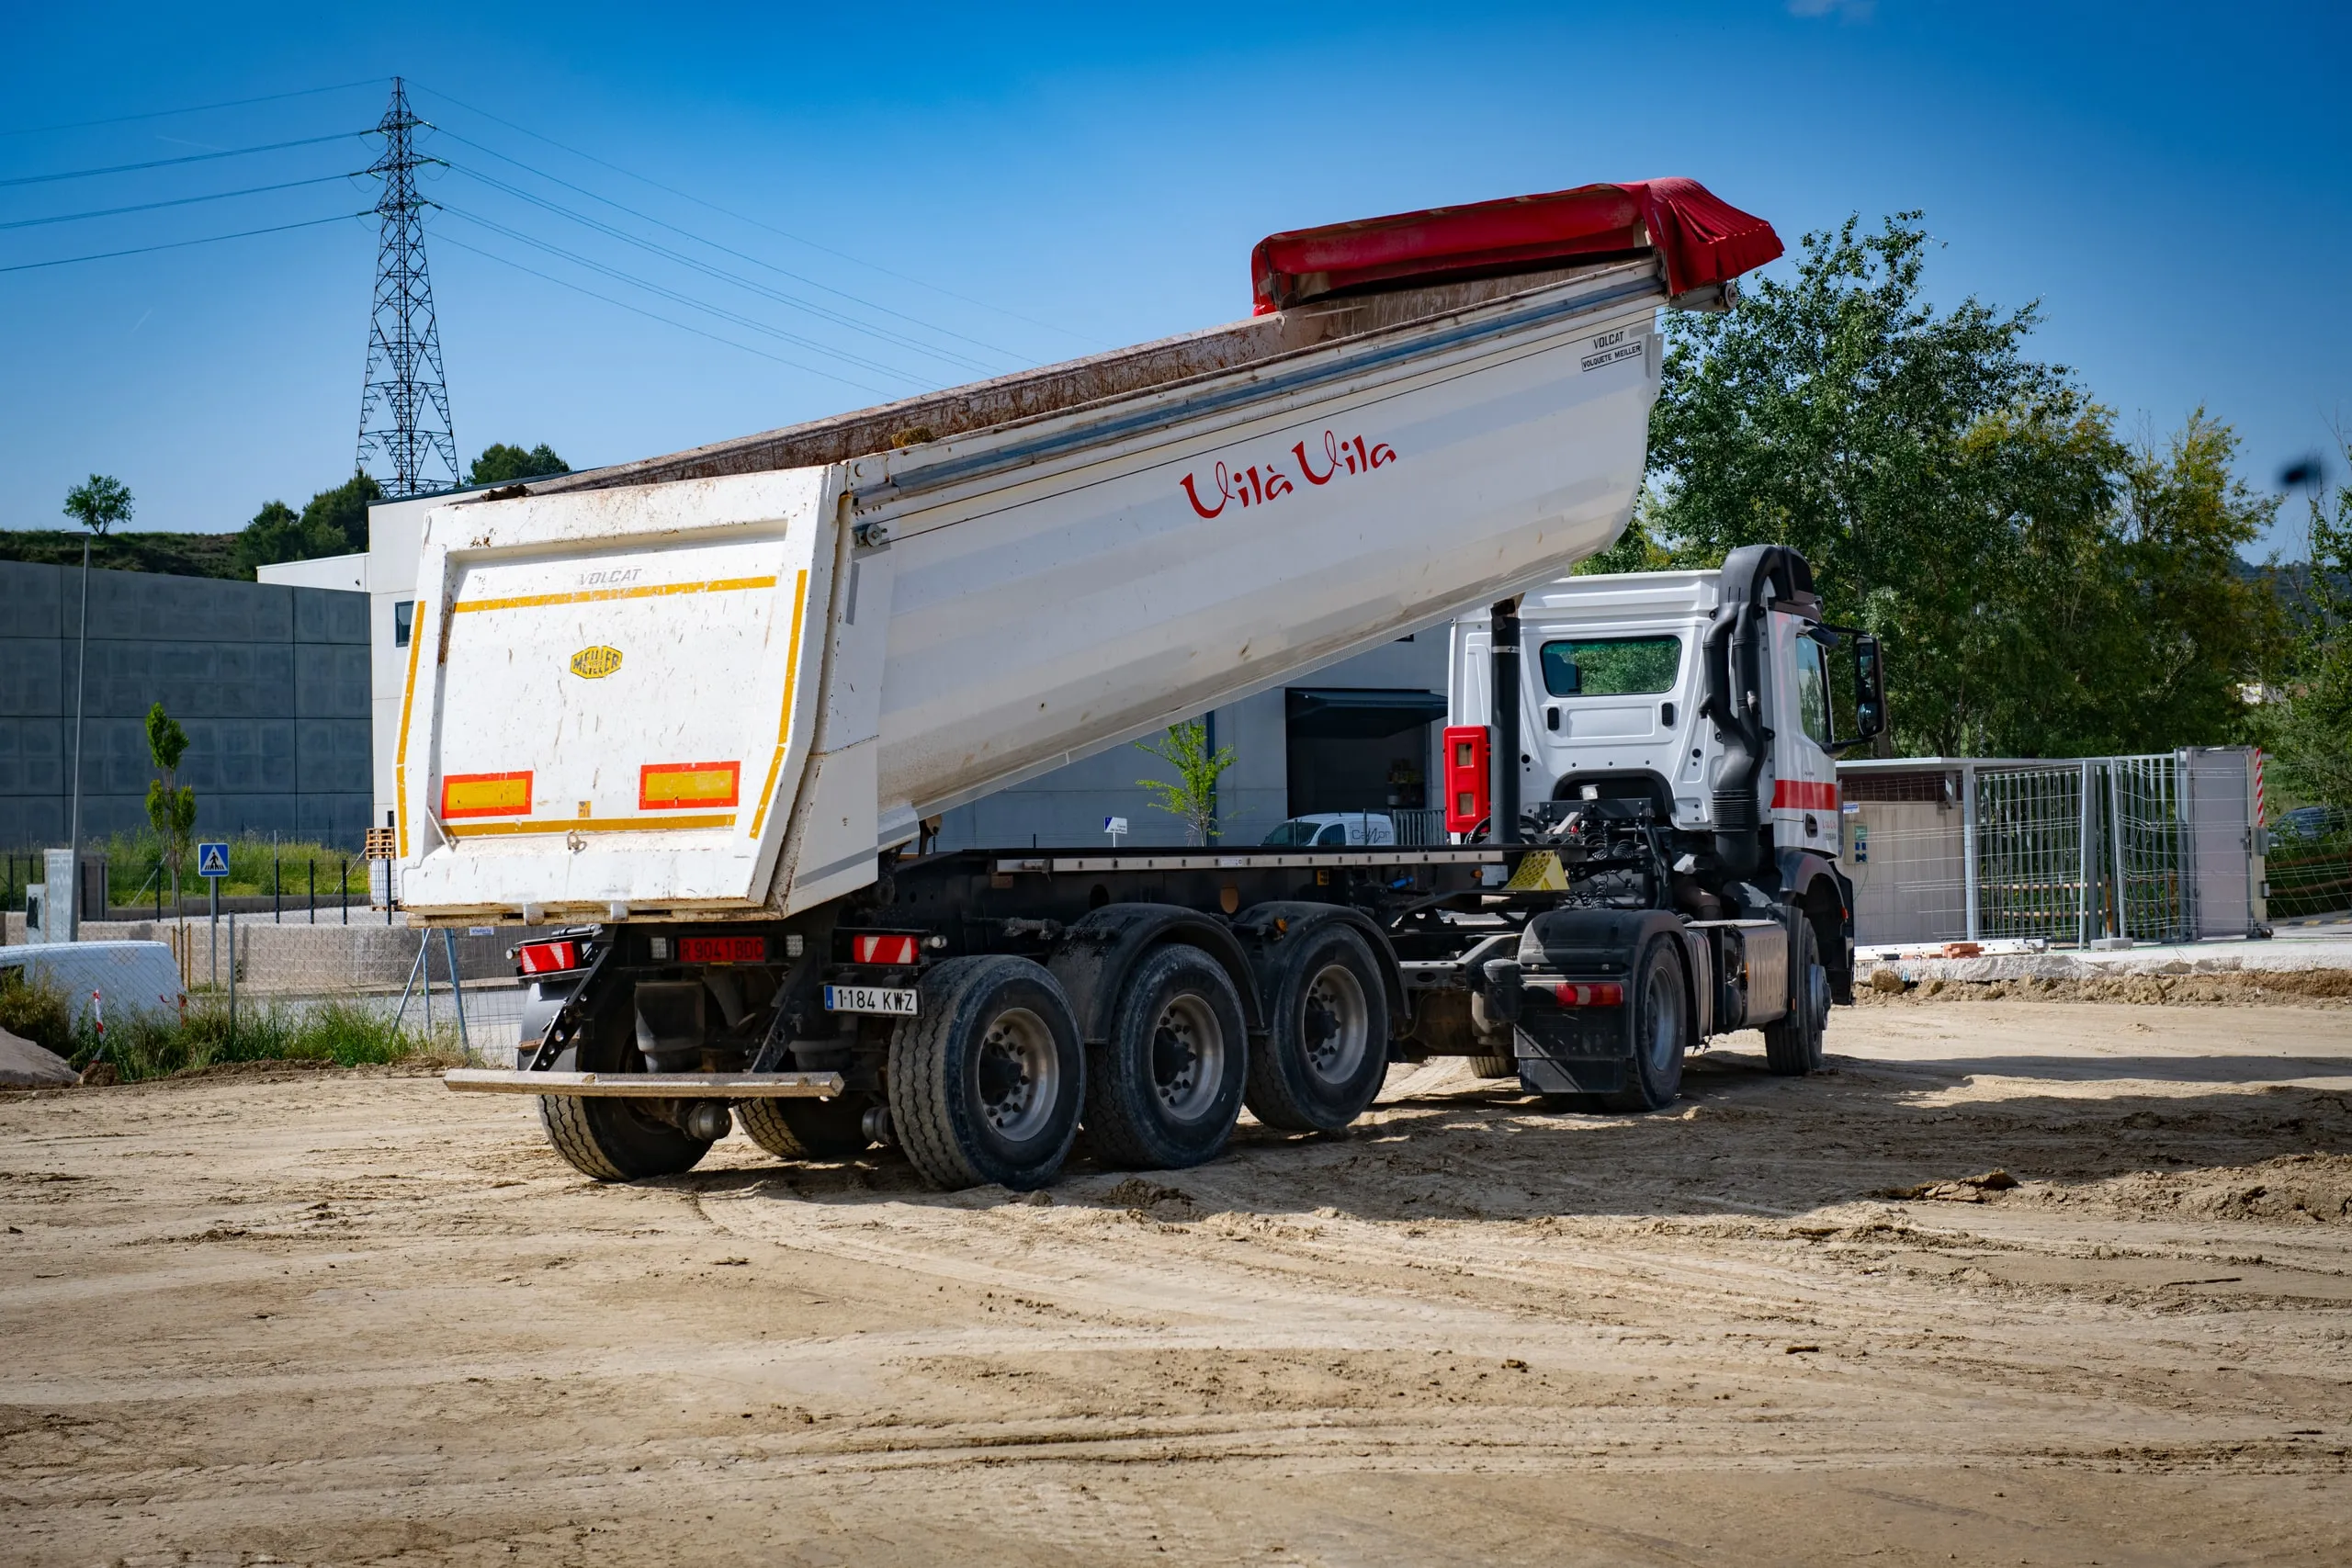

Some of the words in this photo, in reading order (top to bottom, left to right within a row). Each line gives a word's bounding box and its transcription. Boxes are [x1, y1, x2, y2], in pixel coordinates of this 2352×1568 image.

[1593, 331, 1624, 349] VOLCAT
[1583, 353, 1611, 368] VOLQUETE
[1614, 344, 1641, 359] MEILLER
[579, 569, 642, 585] VOLCAT
[838, 989, 876, 1010] 1184
[883, 991, 913, 1011] KWZ
